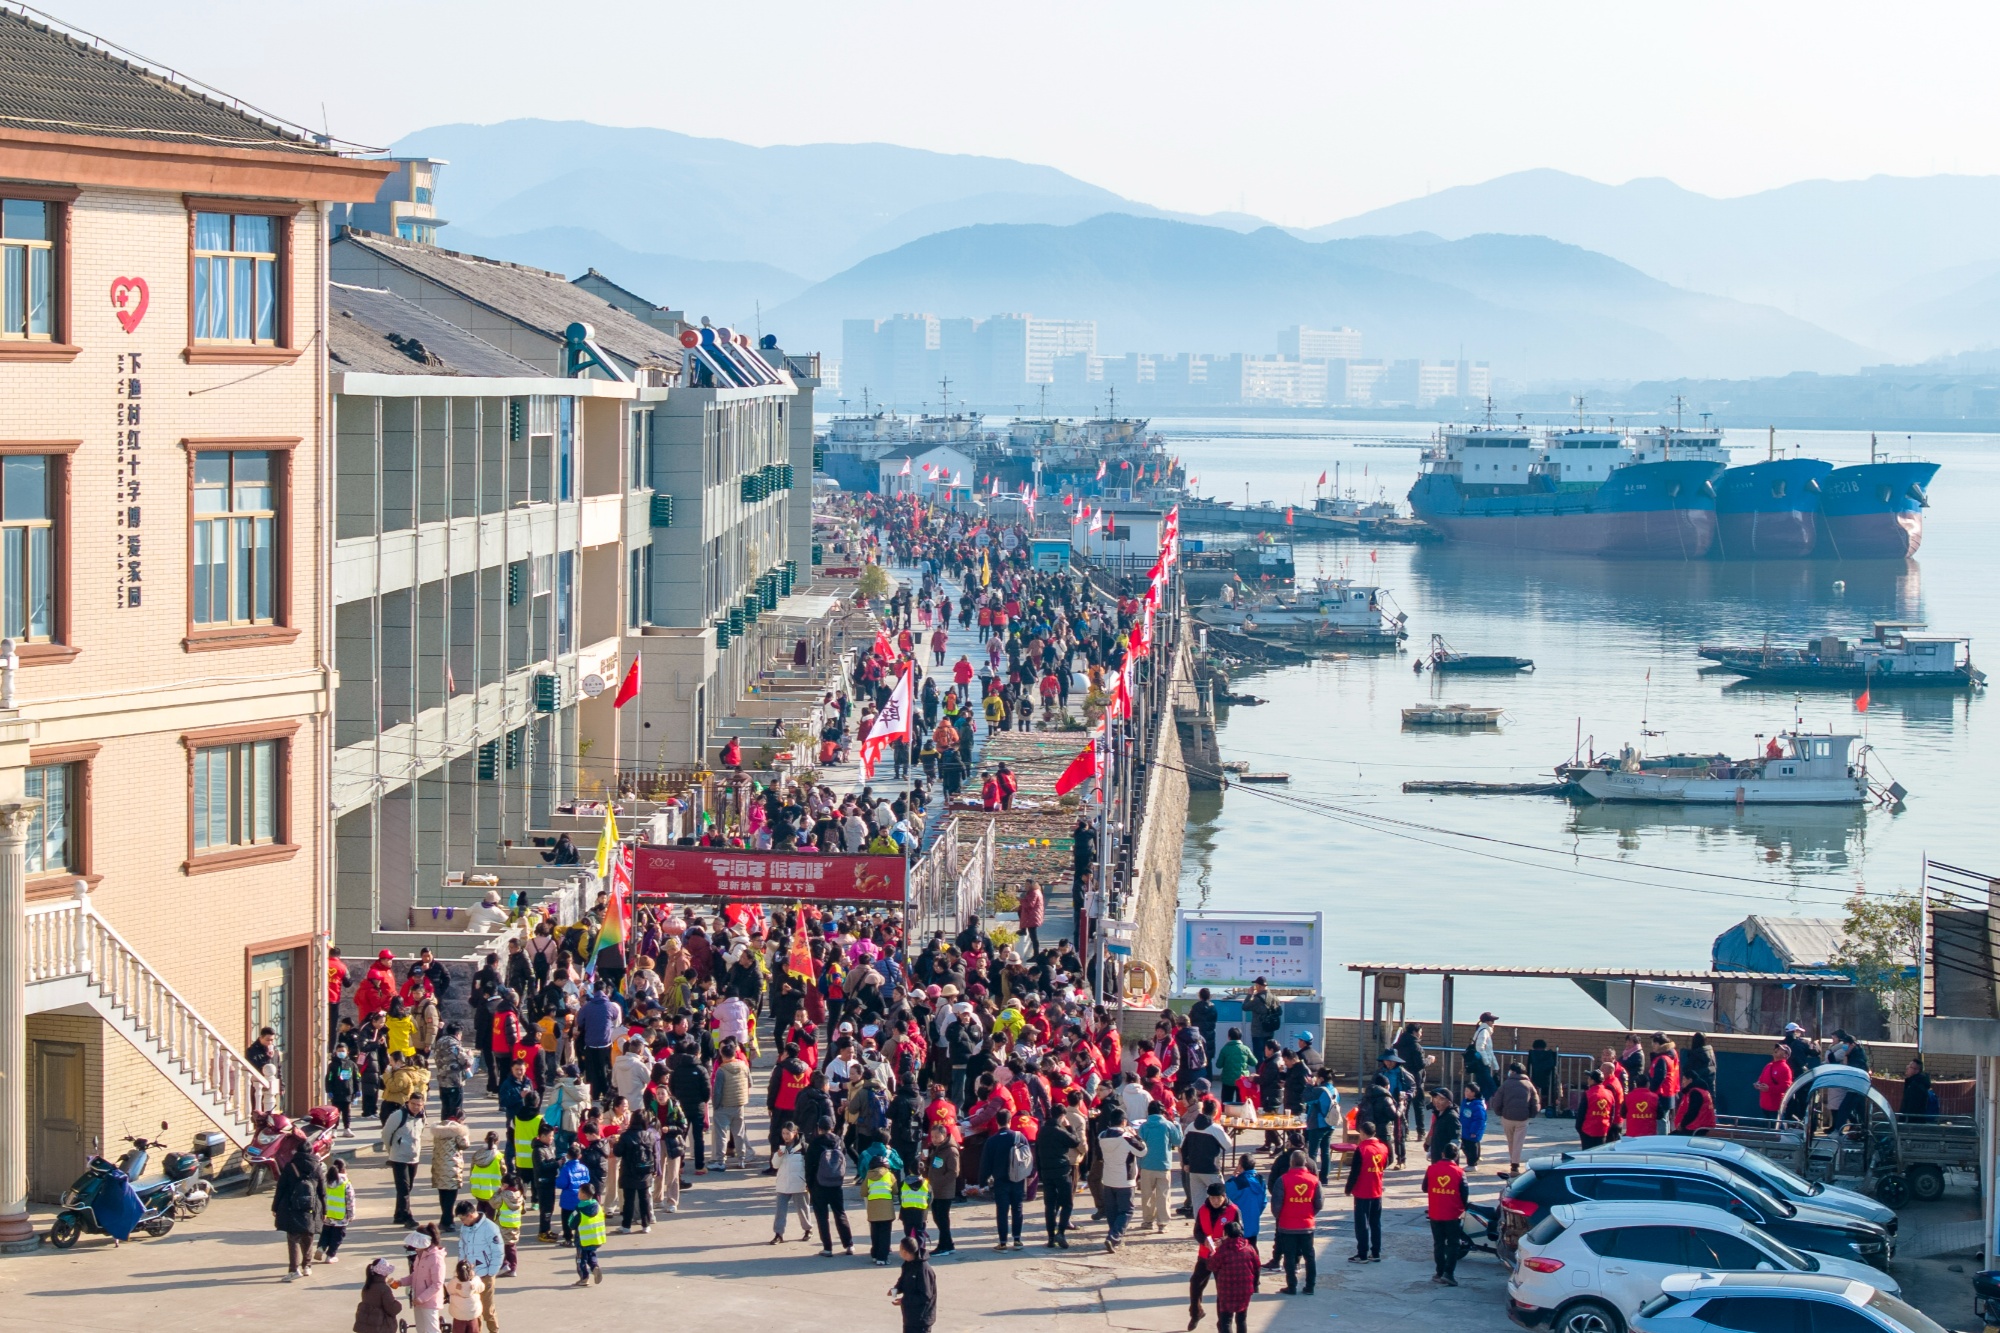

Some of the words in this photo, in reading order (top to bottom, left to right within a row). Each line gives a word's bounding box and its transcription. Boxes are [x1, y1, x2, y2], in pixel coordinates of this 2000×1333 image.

[117, 379, 124, 394] YU
[127, 352, 142, 608] 下渔村红十字博爱家园
[648, 857, 675, 868] 2024
[718, 880, 762, 891] 迎新纳福
